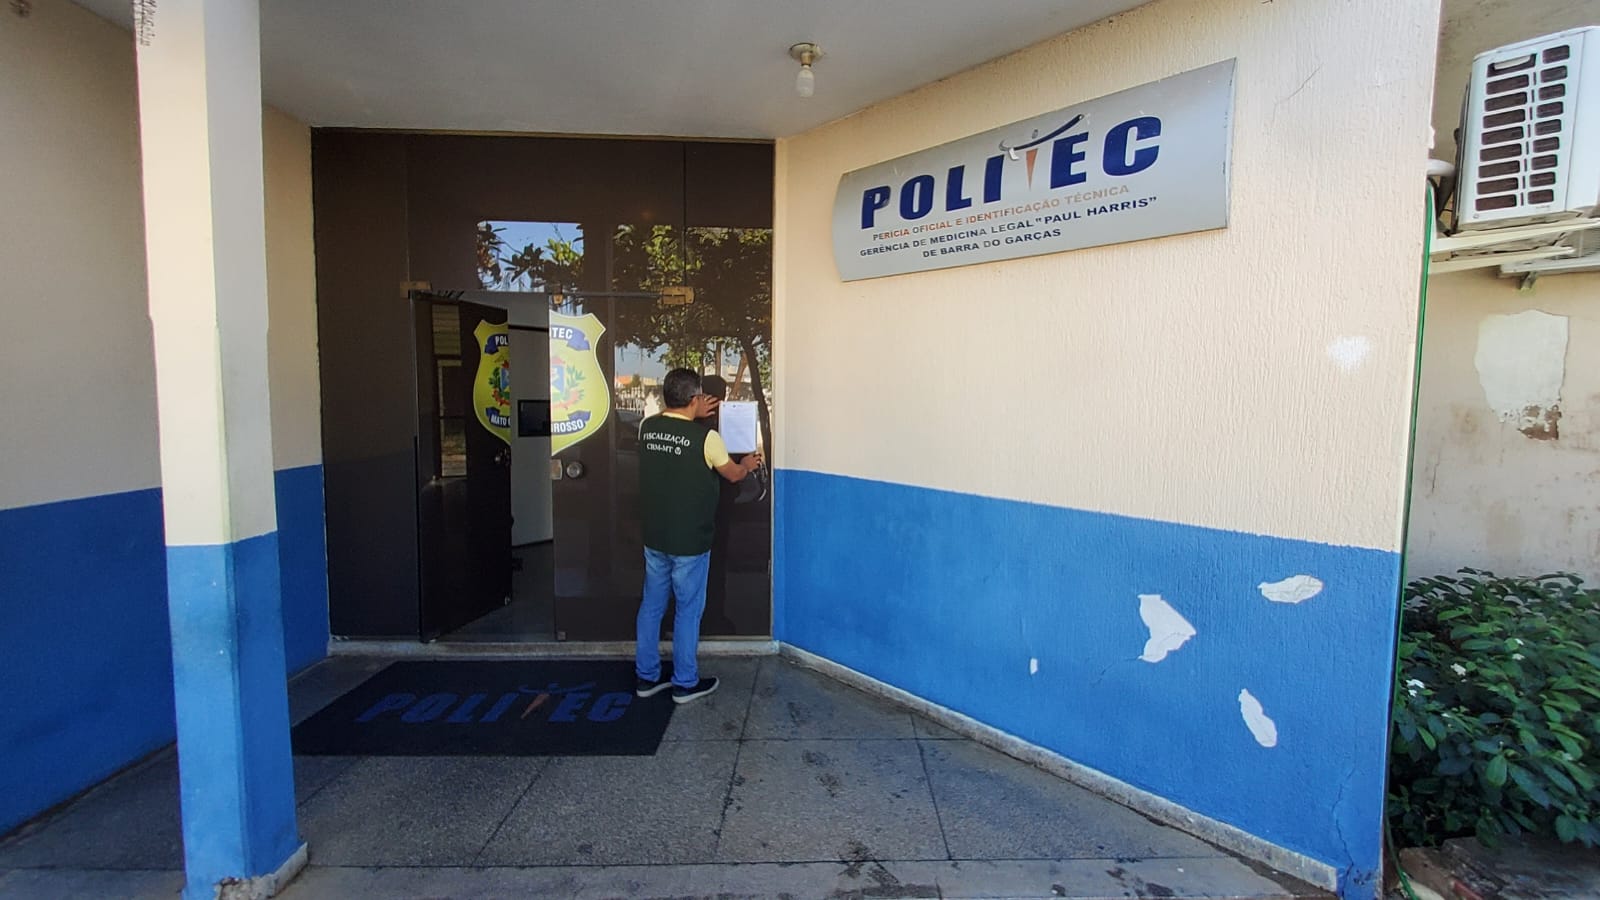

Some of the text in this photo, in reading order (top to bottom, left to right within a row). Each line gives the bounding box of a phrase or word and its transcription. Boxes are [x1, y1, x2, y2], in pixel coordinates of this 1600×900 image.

[860, 113, 1162, 229] POLITEC
[912, 222, 953, 234] OFICIAL
[955, 218, 963, 226] E
[965, 198, 1061, 223] IDENTIFICAÇÃO
[1064, 184, 1130, 206] TÉCNICA
[860, 241, 910, 257] GERÊNCIA
[912, 238, 928, 248] DE
[929, 228, 988, 245] MEDICINA
[991, 220, 1034, 234] LEGAL
[922, 228, 1063, 258] DE BARRA DO GARÇAS
[643, 432, 691, 447] FISCALIZAÇÃO
[354, 683, 634, 724] POLITEC
